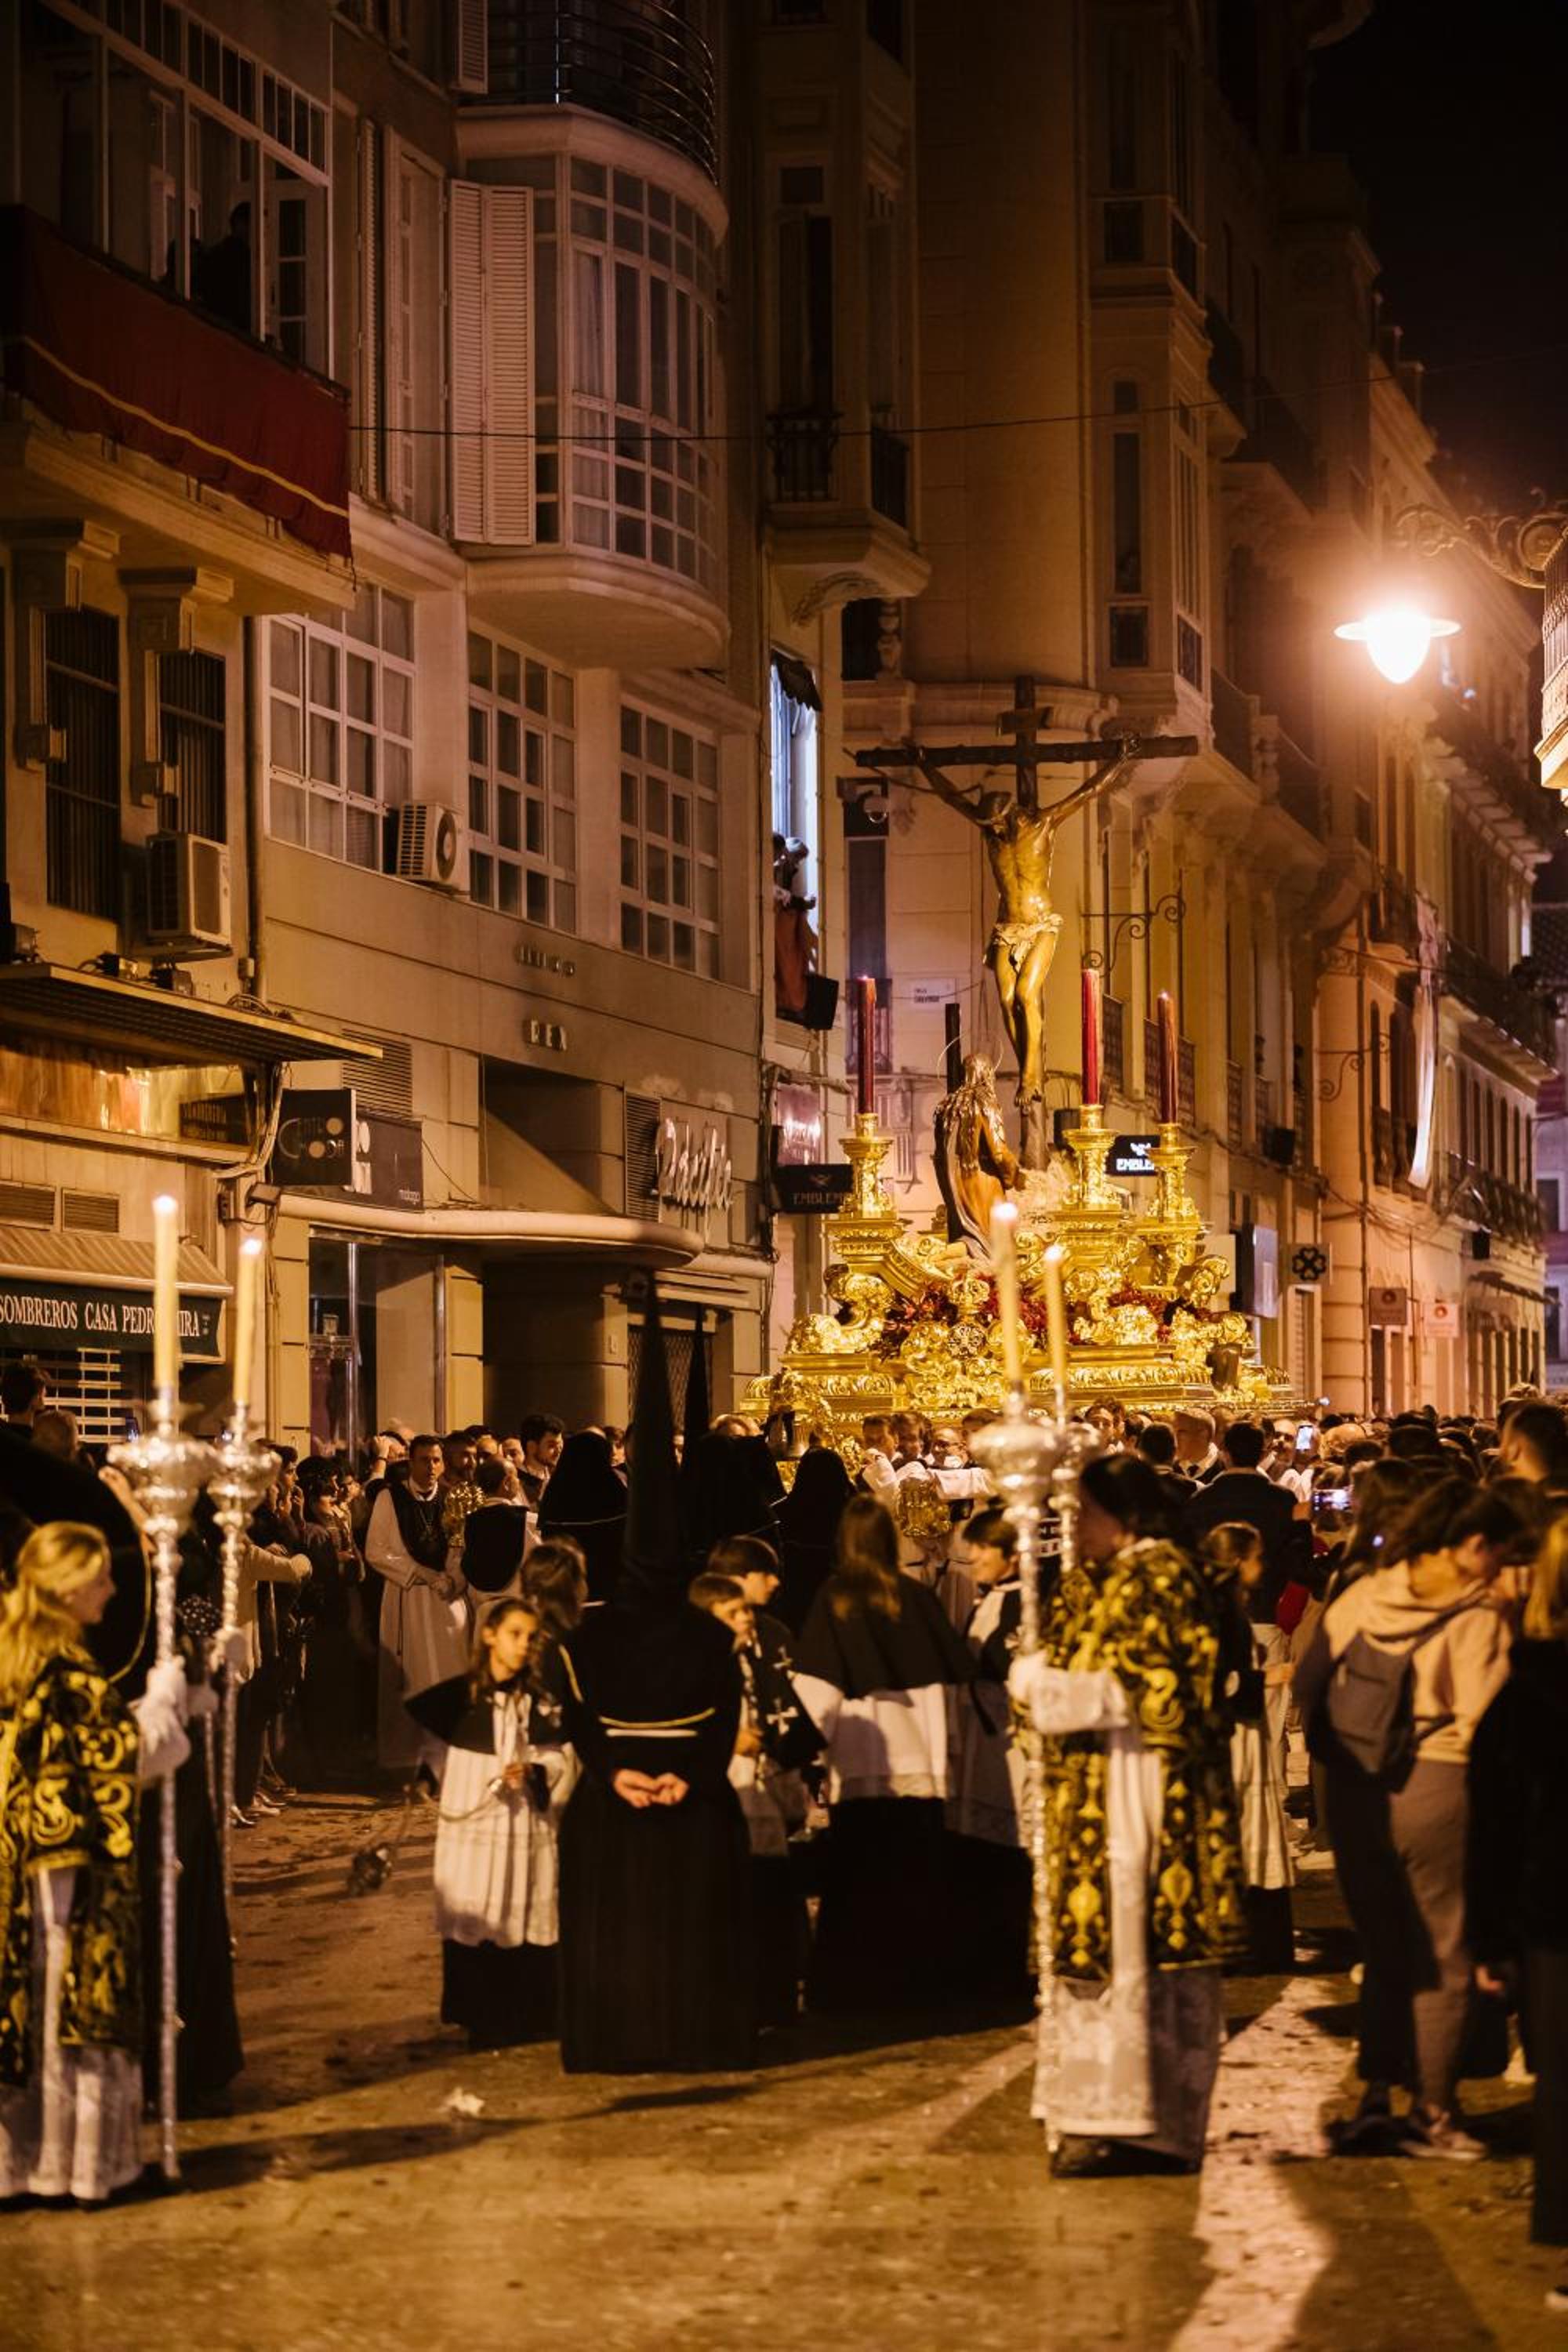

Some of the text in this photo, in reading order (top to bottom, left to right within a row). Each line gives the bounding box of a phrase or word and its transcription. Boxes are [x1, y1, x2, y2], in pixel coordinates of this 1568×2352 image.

[531, 1018, 567, 1051] REX
[85, 1301, 118, 1331] CASA
[122, 1305, 156, 1334] PEDR
[177, 1310, 200, 1337] IRA
